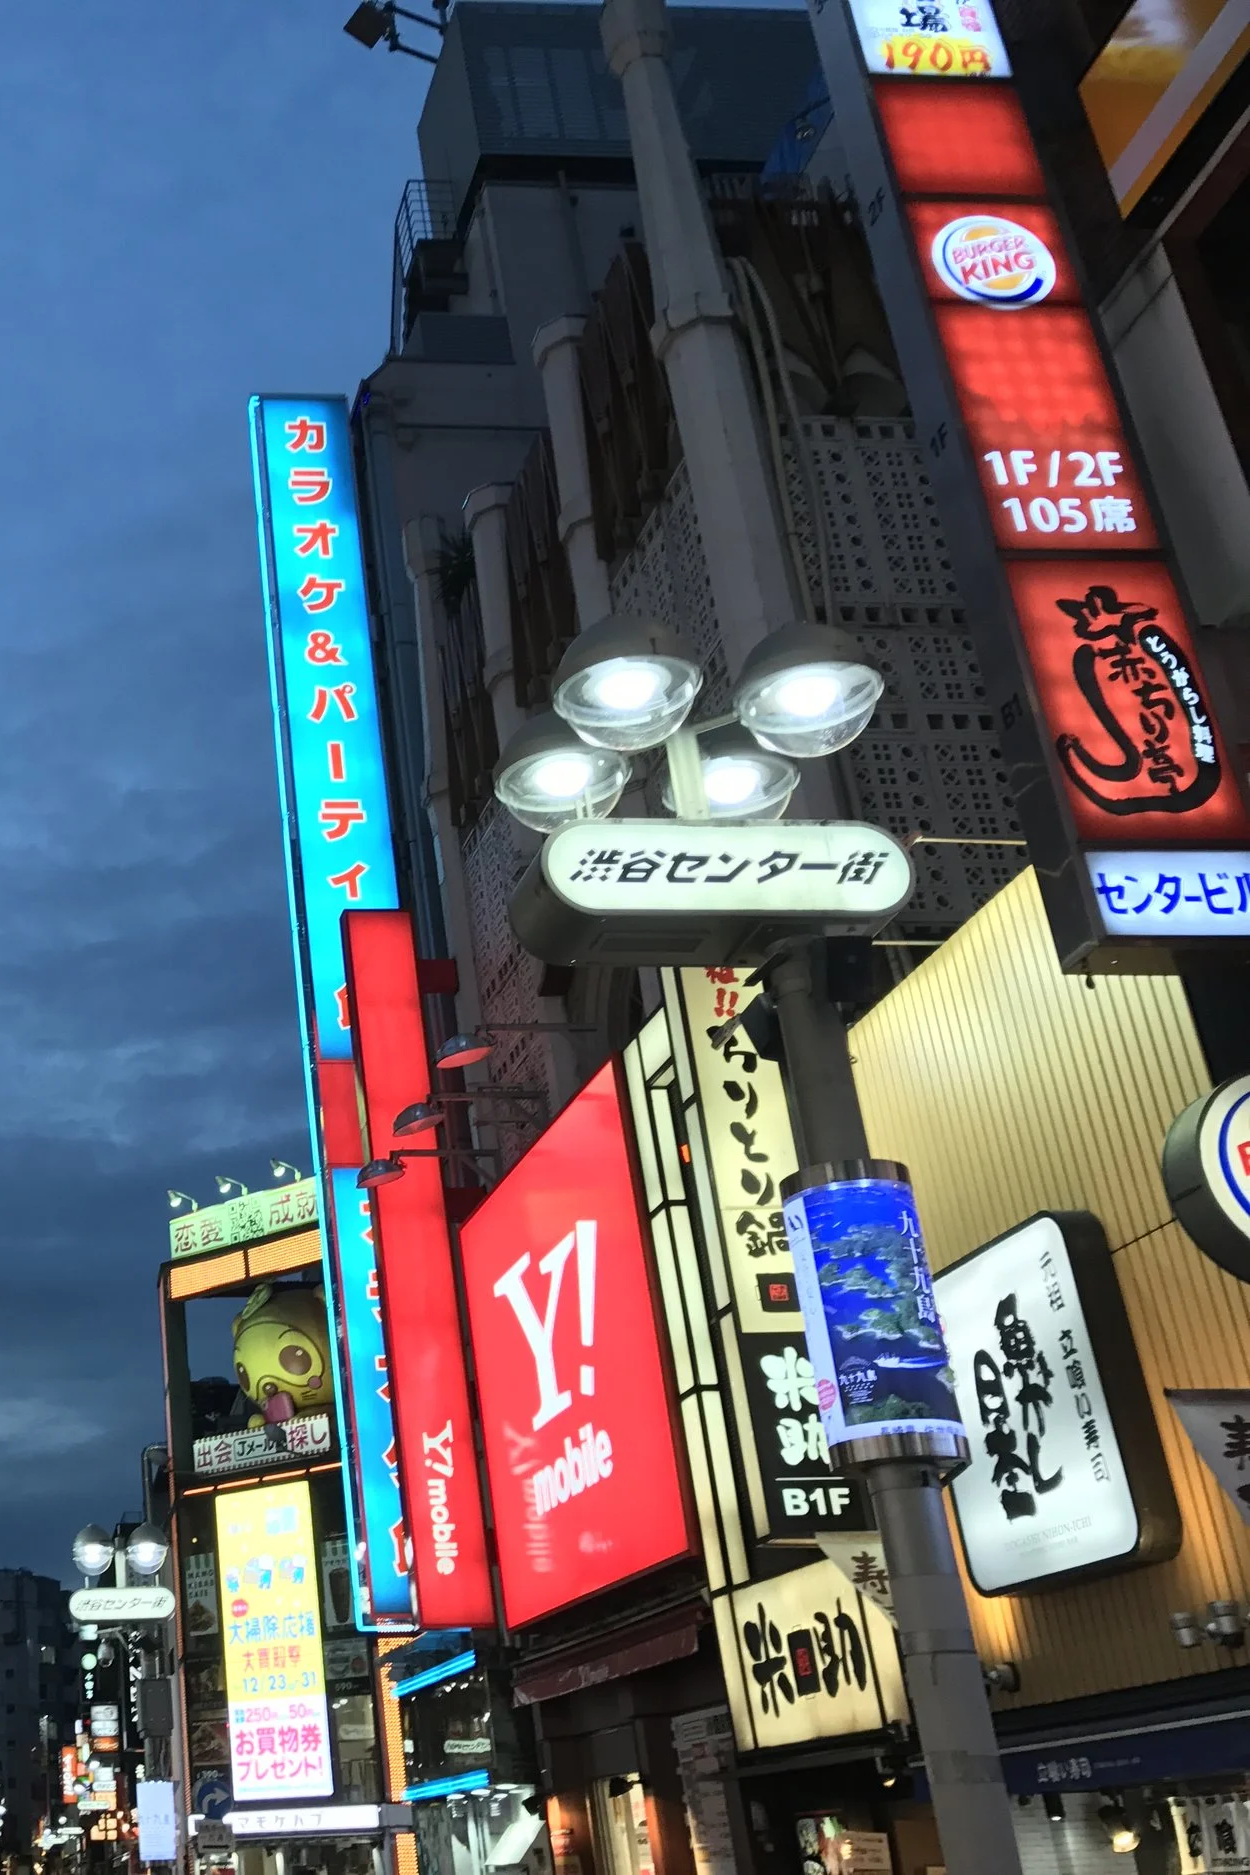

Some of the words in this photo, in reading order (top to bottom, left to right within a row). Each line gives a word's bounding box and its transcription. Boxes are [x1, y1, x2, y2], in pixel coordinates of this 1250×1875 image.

[884, 40, 991, 71] 190円
[952, 234, 1029, 263] BURGER
[960, 254, 1037, 285] KING
[1000, 496, 1137, 534] 105席
[285, 417, 371, 902] カラオケ&パーティ
[570, 847, 892, 885] 渋谷センター街
[174, 1218, 223, 1253] 恋愛
[897, 1209, 936, 1323] 九十九島
[494, 1219, 597, 1431] Y!
[287, 1423, 326, 1449] 探し
[196, 1440, 233, 1468] 出会
[533, 1420, 613, 1515] mobile
[783, 1486, 850, 1516] B1F
[429, 1478, 456, 1576] mobile
[228, 1611, 317, 1646] 大掃除応援
[235, 1723, 322, 1756] お買物券
[237, 1756, 323, 1782] プレゼント!
